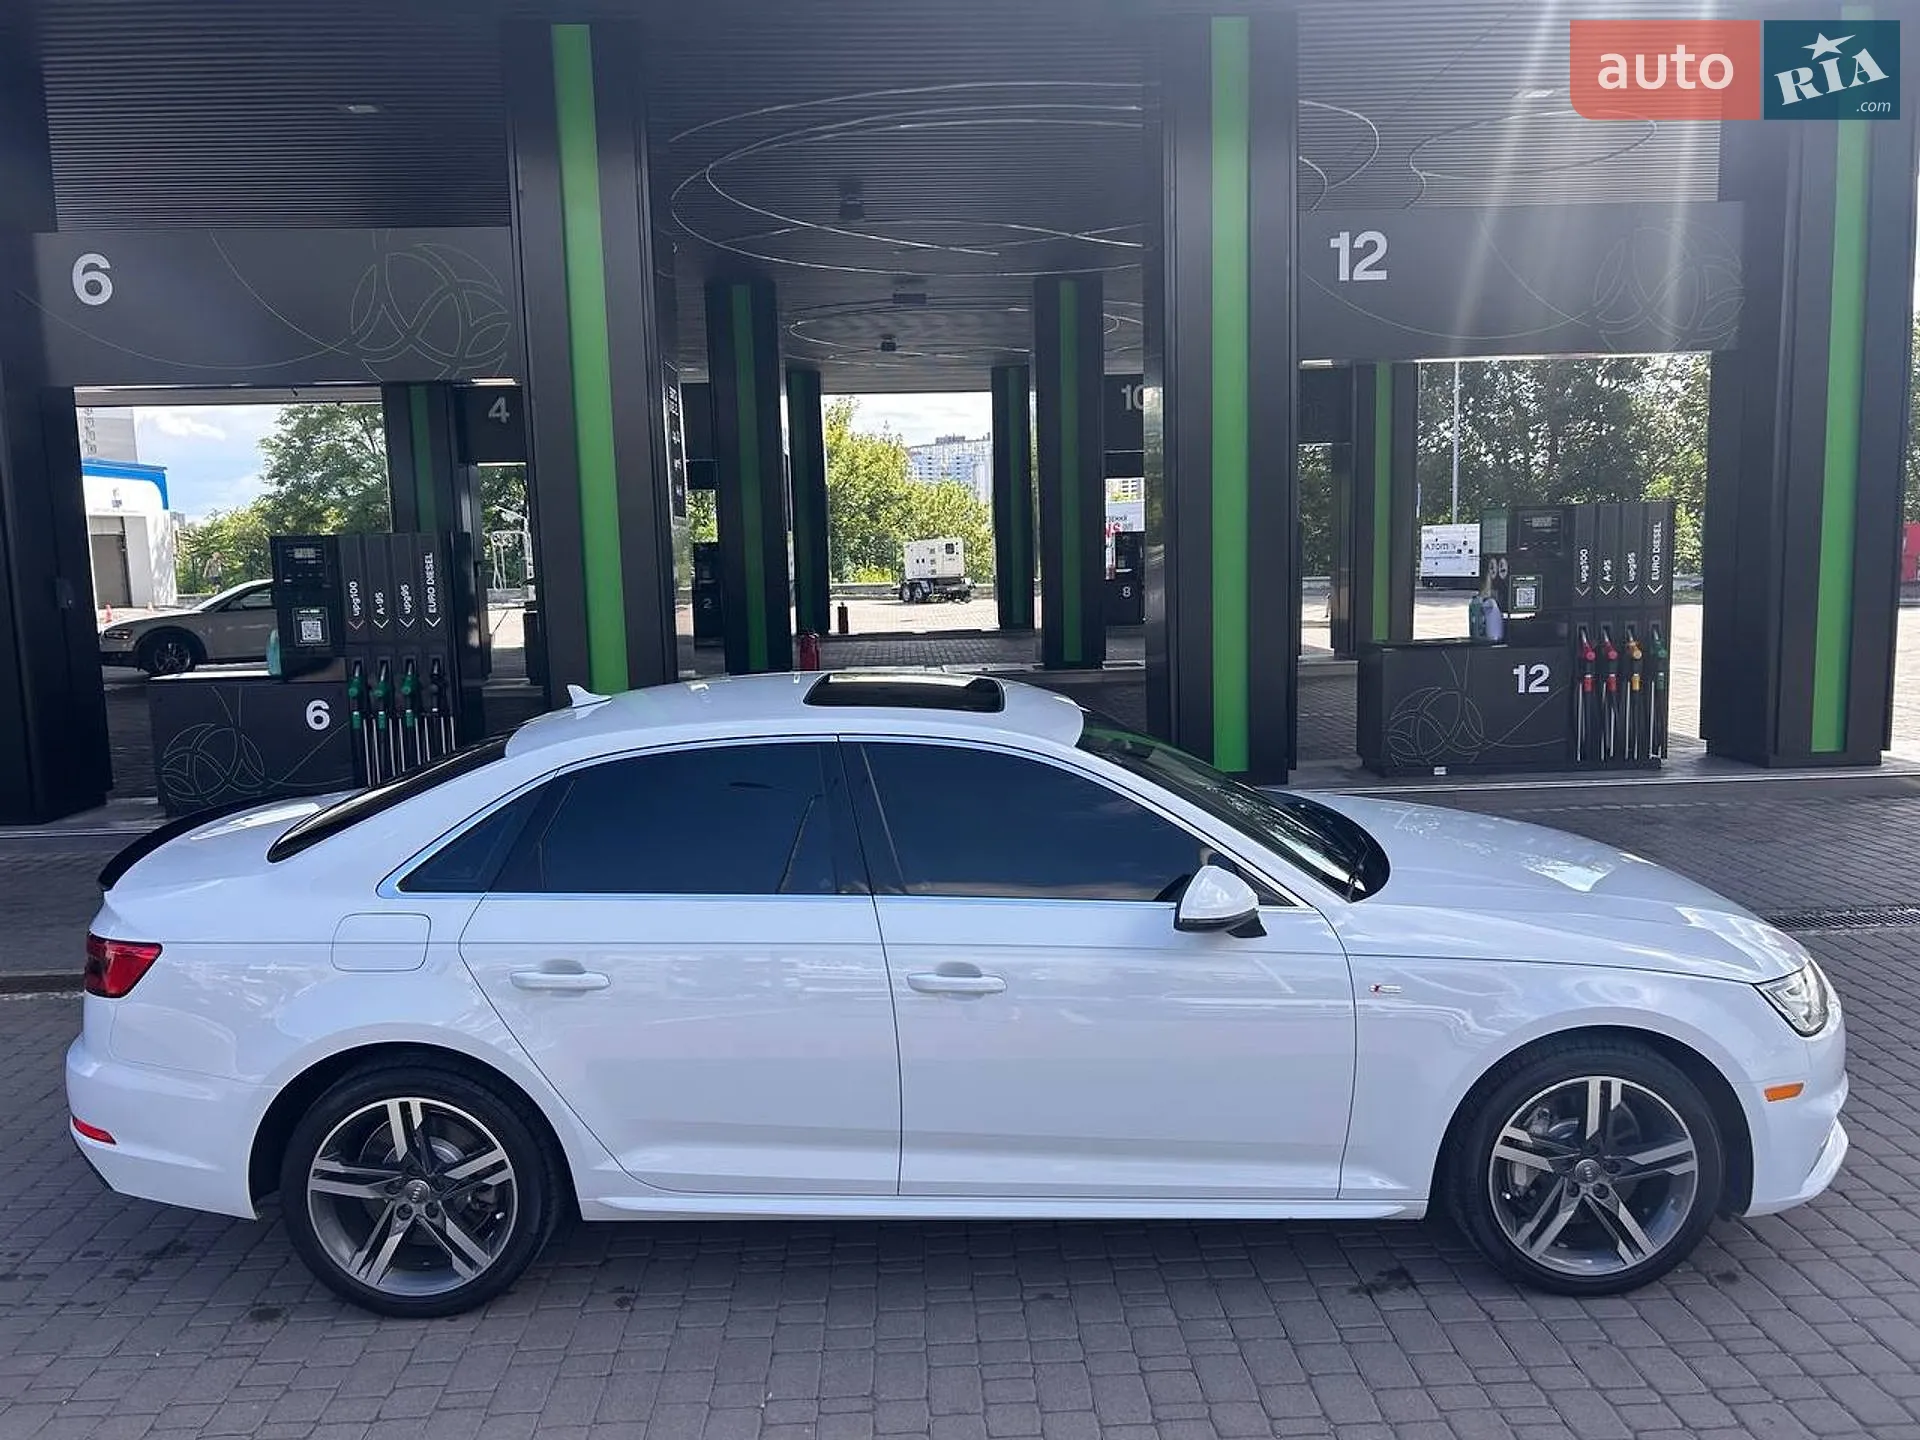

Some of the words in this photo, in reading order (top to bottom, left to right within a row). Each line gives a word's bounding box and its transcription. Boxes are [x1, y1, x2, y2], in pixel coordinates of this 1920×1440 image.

[1329, 231, 1388, 282] 12
[71, 252, 113, 306] 6
[488, 396, 510, 423] 4
[1652, 521, 1662, 553] DIESEL
[424, 552, 435, 585] DIESEL
[1580, 549, 1589, 582] upg100
[1602, 560, 1611, 581] A-95
[1627, 552, 1637, 581] upg95
[1651, 555, 1661, 580] EURO
[349, 581, 361, 616] upg100
[375, 592, 385, 615] A-95
[400, 584, 412, 614] upg95
[427, 587, 437, 613] EURO
[703, 598, 713, 609] 2
[1122, 586, 1132, 598] 8
[1512, 664, 1550, 694] 12
[306, 699, 331, 730] 6
